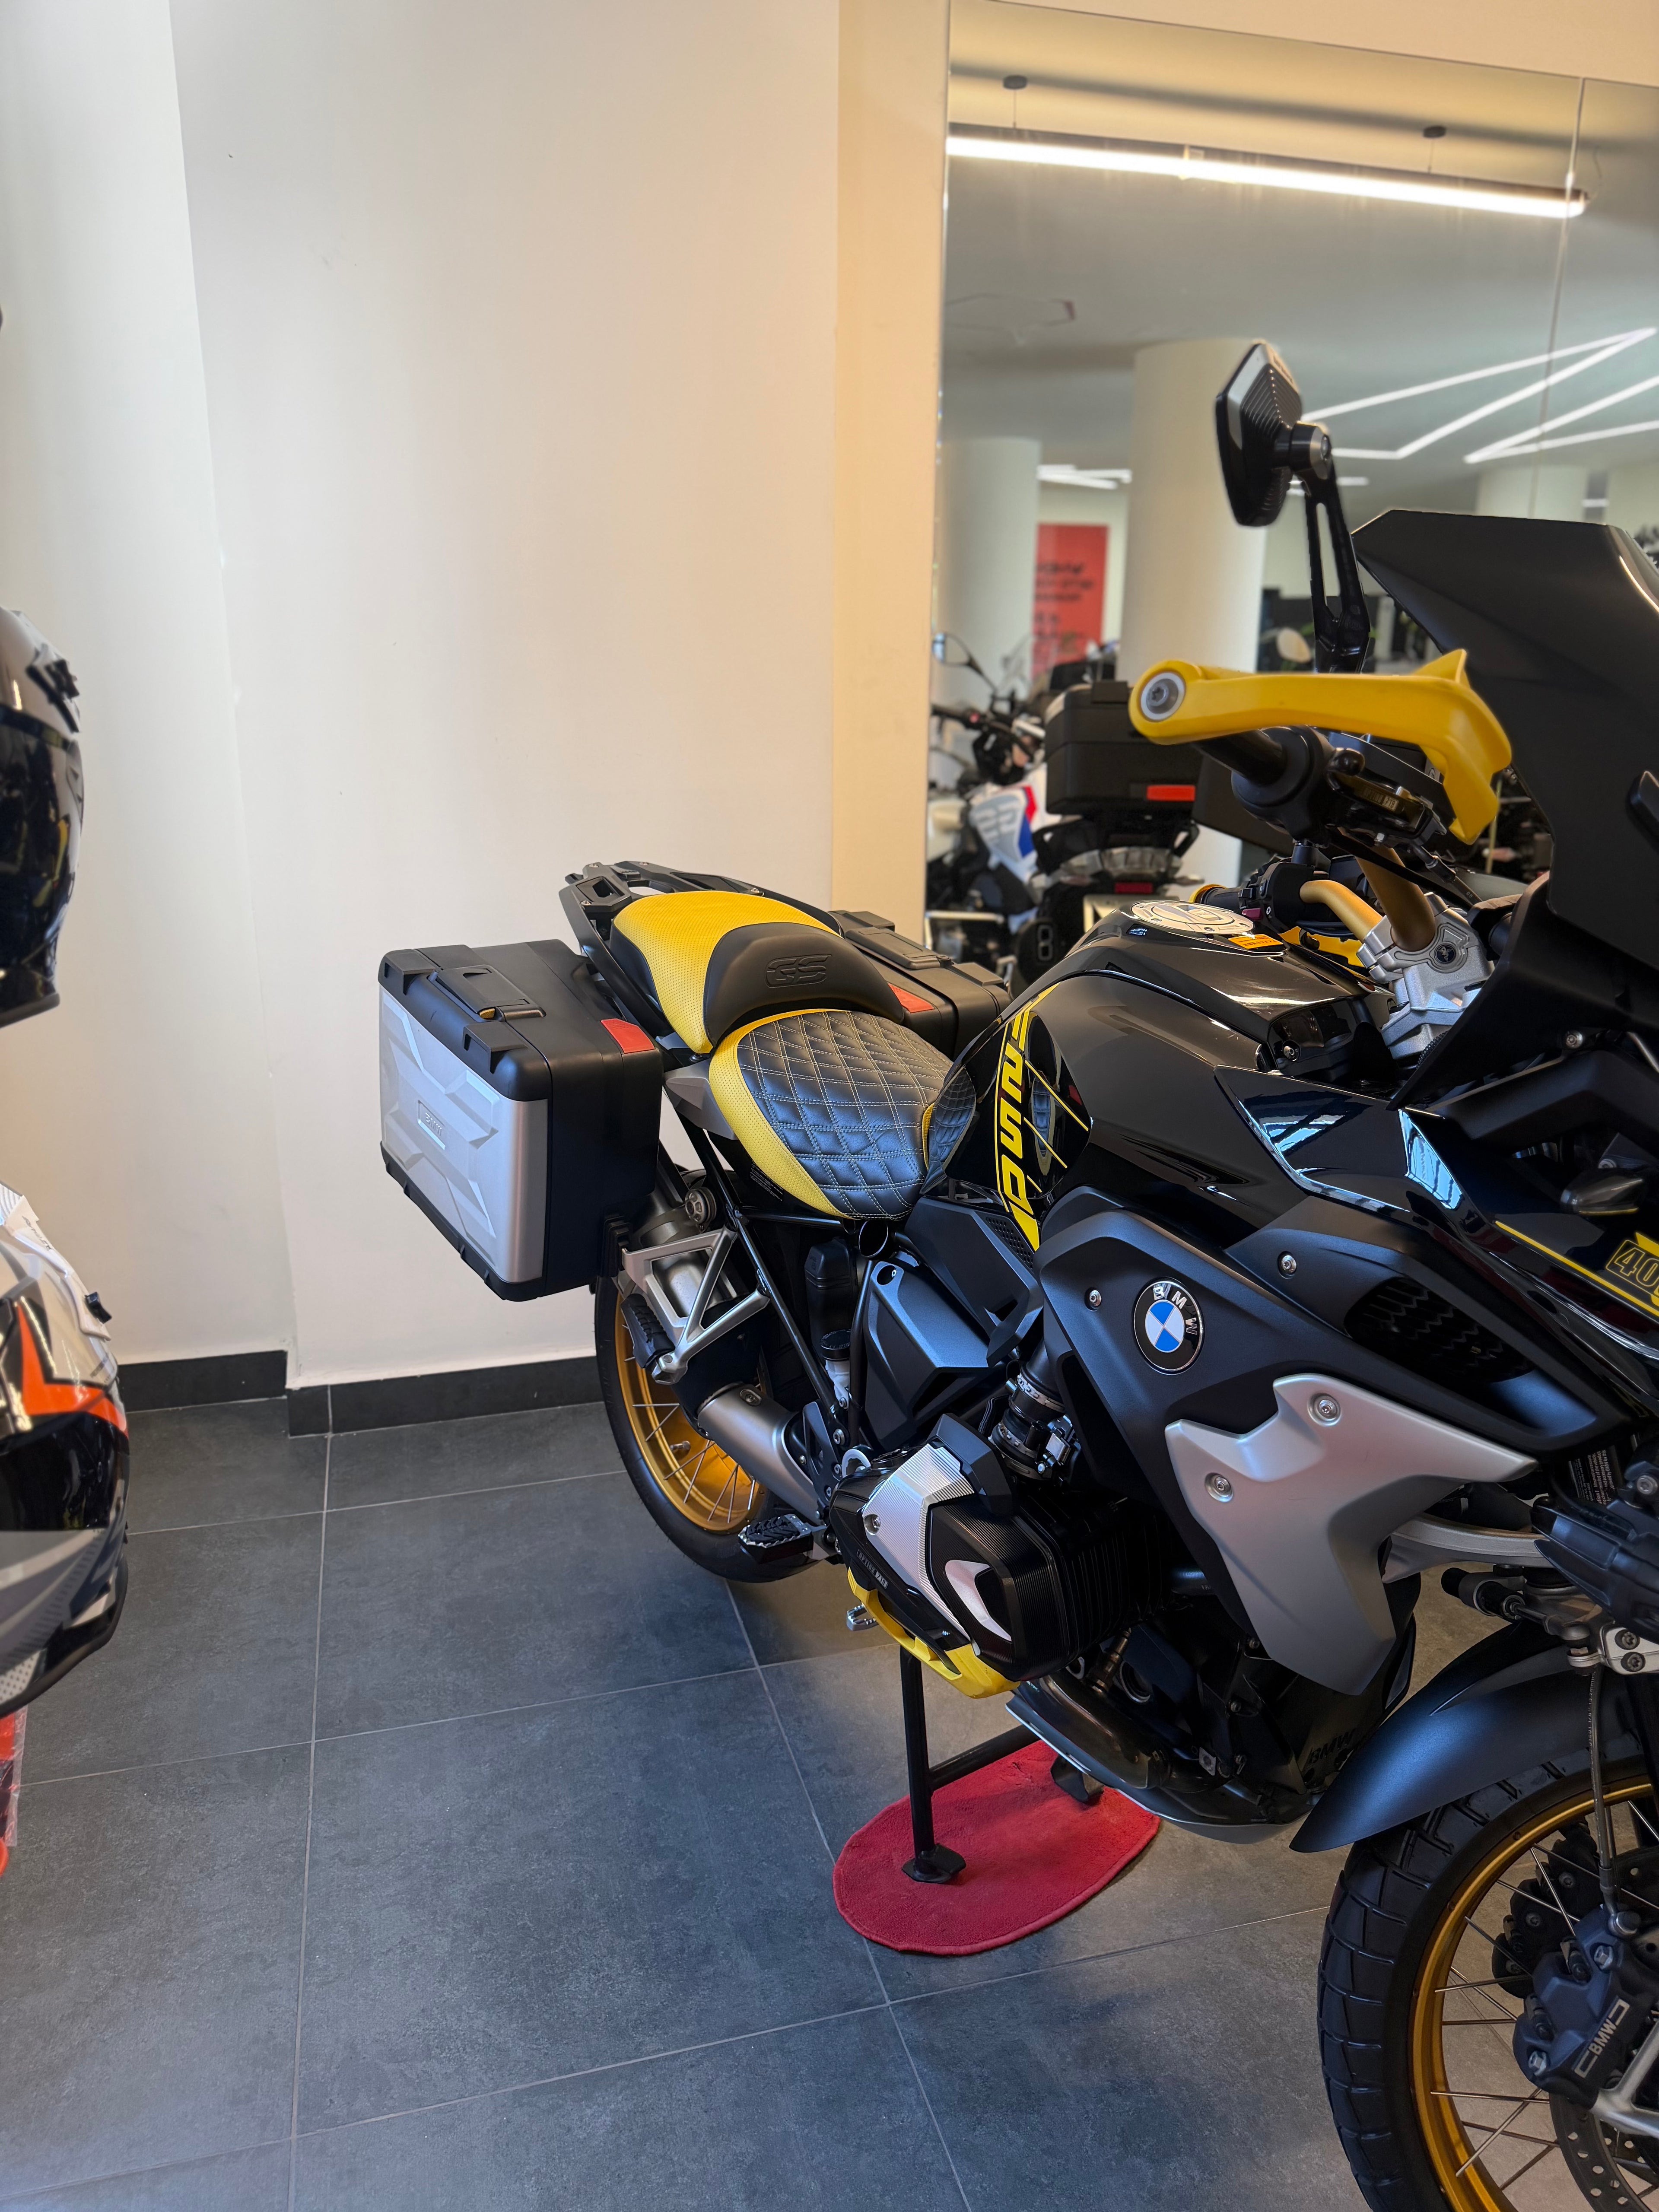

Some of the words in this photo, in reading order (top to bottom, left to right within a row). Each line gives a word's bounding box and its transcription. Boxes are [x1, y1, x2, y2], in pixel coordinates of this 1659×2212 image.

[1385, 798, 1395, 808] 719
[765, 953, 833, 988] GS
[1153, 1286, 1198, 1335] BMW
[1308, 1728, 1356, 1764] BMW
[1588, 2019, 1617, 2055] BMW
